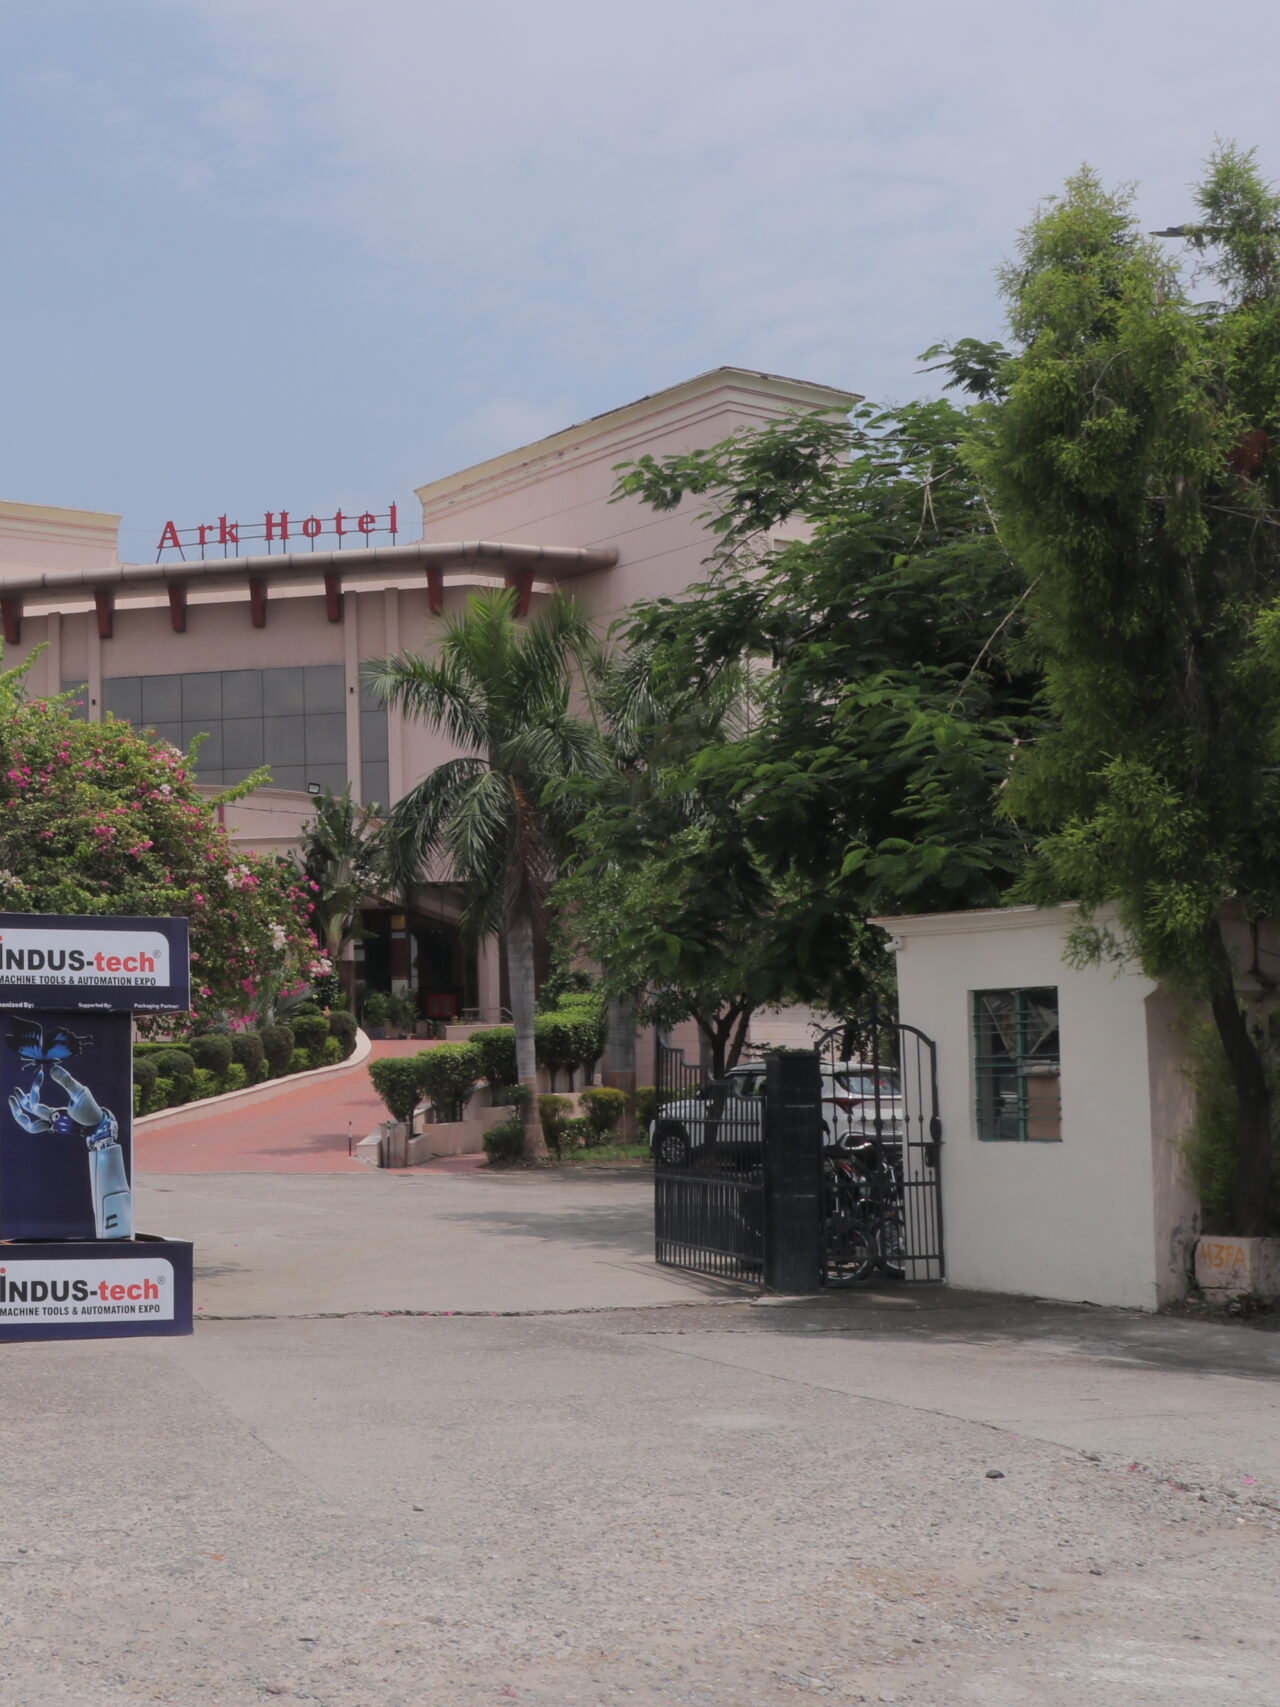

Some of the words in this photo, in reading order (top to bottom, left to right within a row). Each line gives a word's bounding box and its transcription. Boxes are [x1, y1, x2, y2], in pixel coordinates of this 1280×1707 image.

[157, 515, 240, 549] Ark
[264, 504, 399, 541] Hotel
[39, 975, 66, 984] TOOLS
[68, 976, 74, 985] &
[77, 976, 132, 985] AUTOMATION
[134, 977, 157, 986] EXPO
[0, 1307, 40, 1317] MACHINE
[42, 1306, 69, 1316] TOOLS
[72, 1306, 78, 1315] &
[81, 1305, 136, 1315] AUTOMATION
[138, 1304, 160, 1313] EXPO
